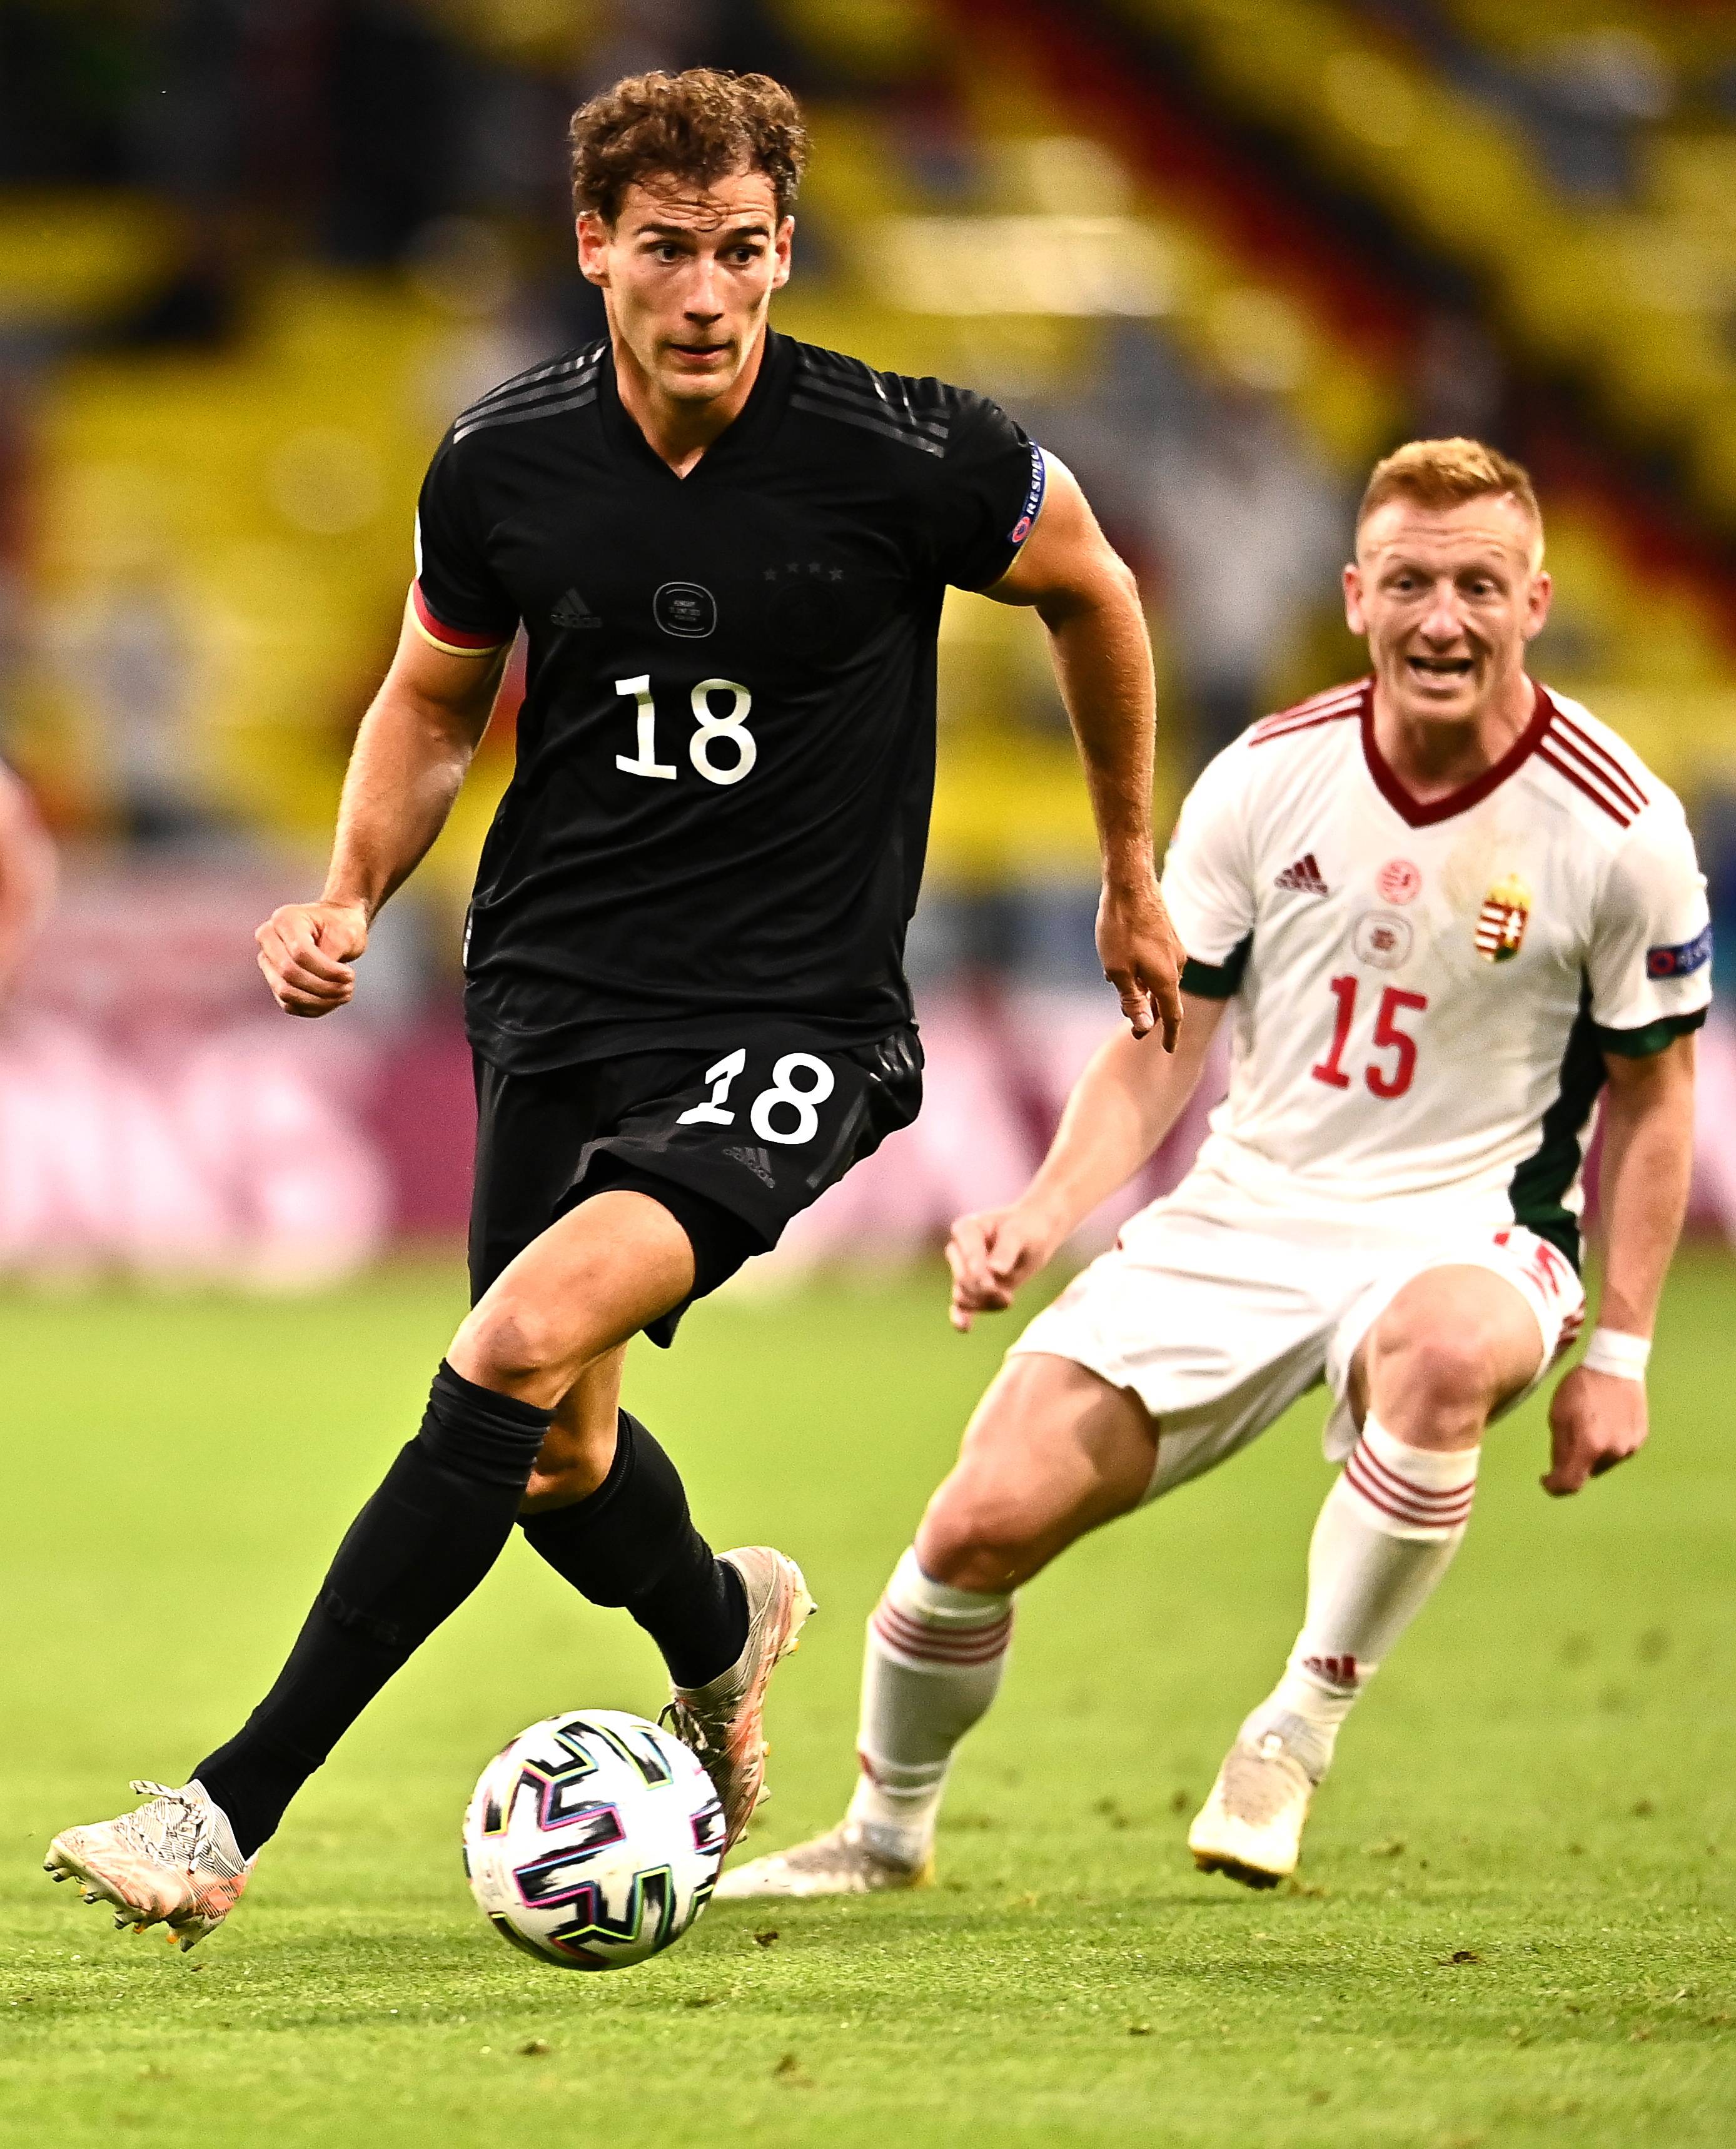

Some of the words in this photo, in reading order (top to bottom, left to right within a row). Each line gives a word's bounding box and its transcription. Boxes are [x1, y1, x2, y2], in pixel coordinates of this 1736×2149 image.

[615, 674, 757, 785] 18
[1311, 973, 1428, 1099] 15
[675, 1048, 835, 1145] 18
